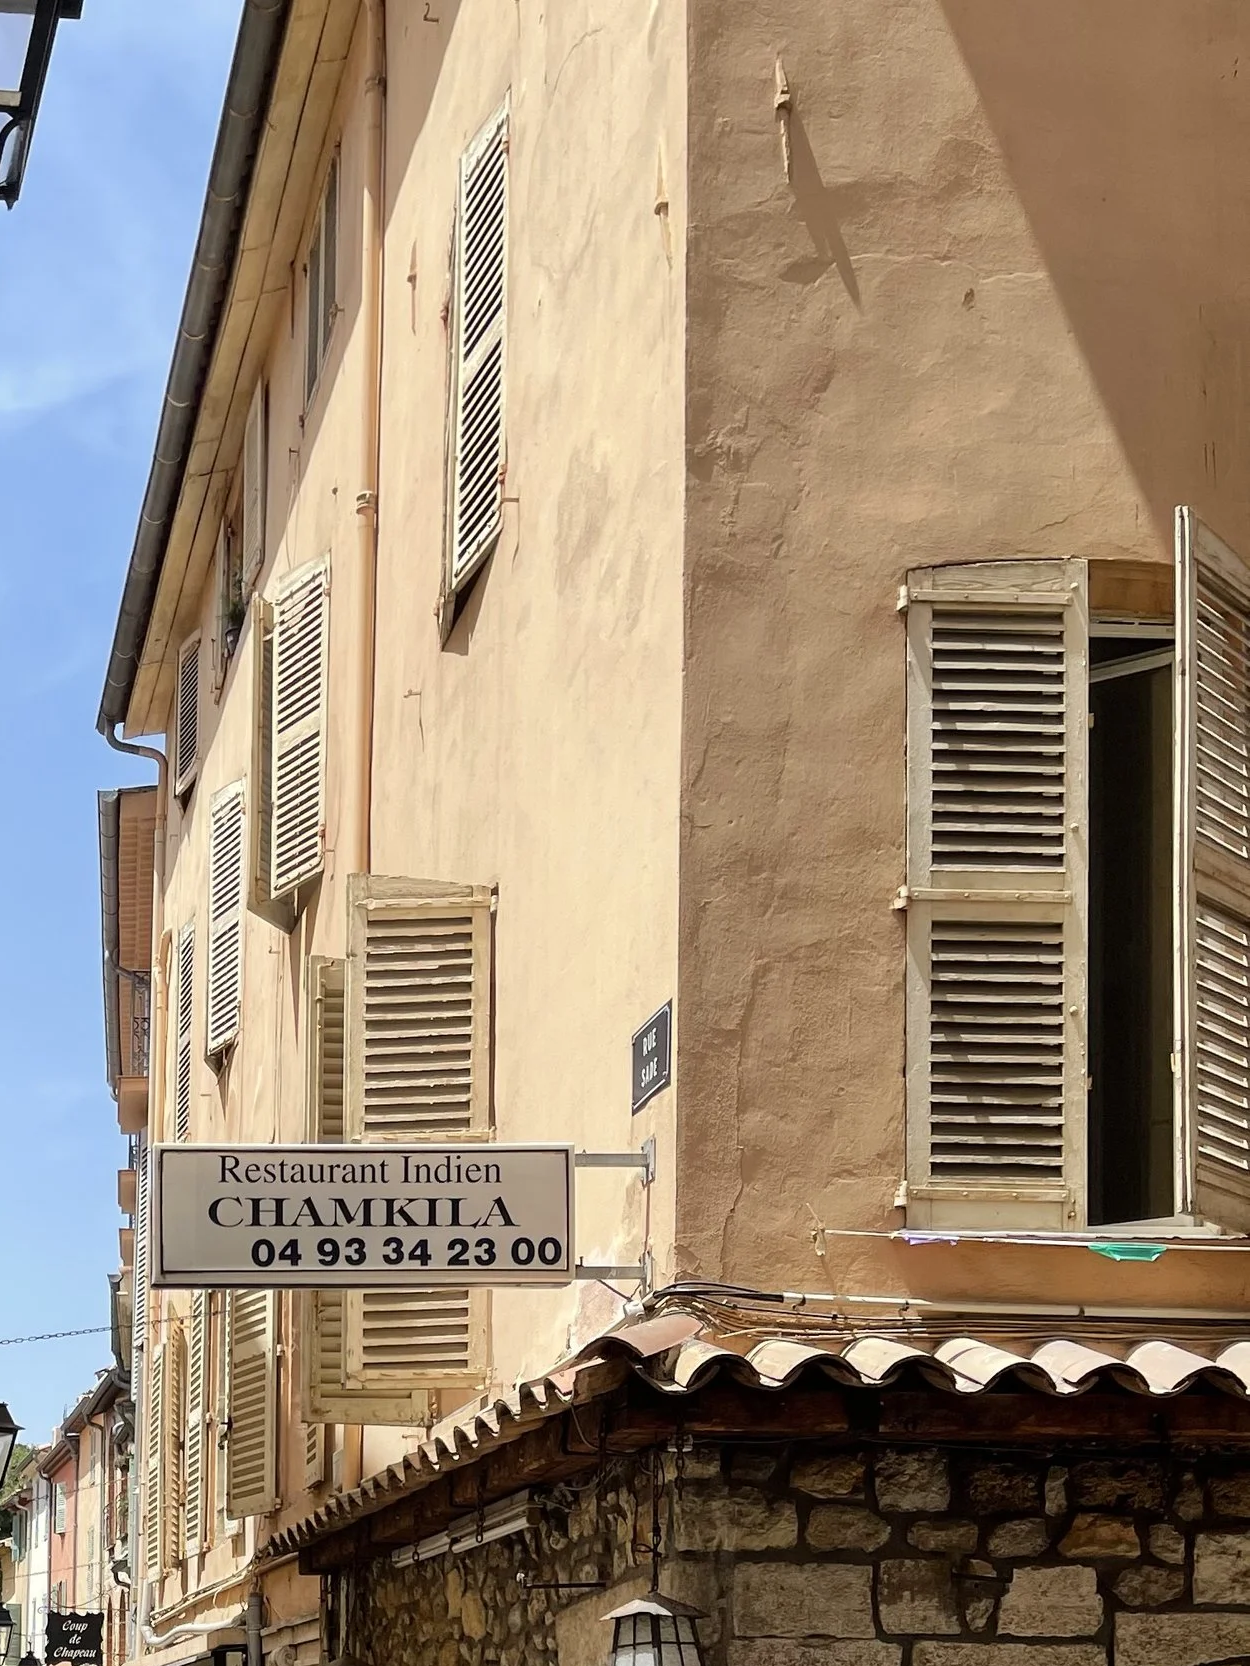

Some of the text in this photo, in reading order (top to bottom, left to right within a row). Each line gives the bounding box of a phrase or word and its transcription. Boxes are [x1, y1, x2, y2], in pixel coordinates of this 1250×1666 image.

[642, 1027, 657, 1057] RUE
[641, 1057, 658, 1088] SADE
[218, 1154, 502, 1184] Restaurant Indien
[207, 1196, 520, 1228] CHAMKILA
[250, 1236, 562, 1267] 04 93 34 23 00
[62, 1619, 89, 1633] Coup
[68, 1633, 82, 1645] de
[53, 1646, 97, 1660] Chapeau
